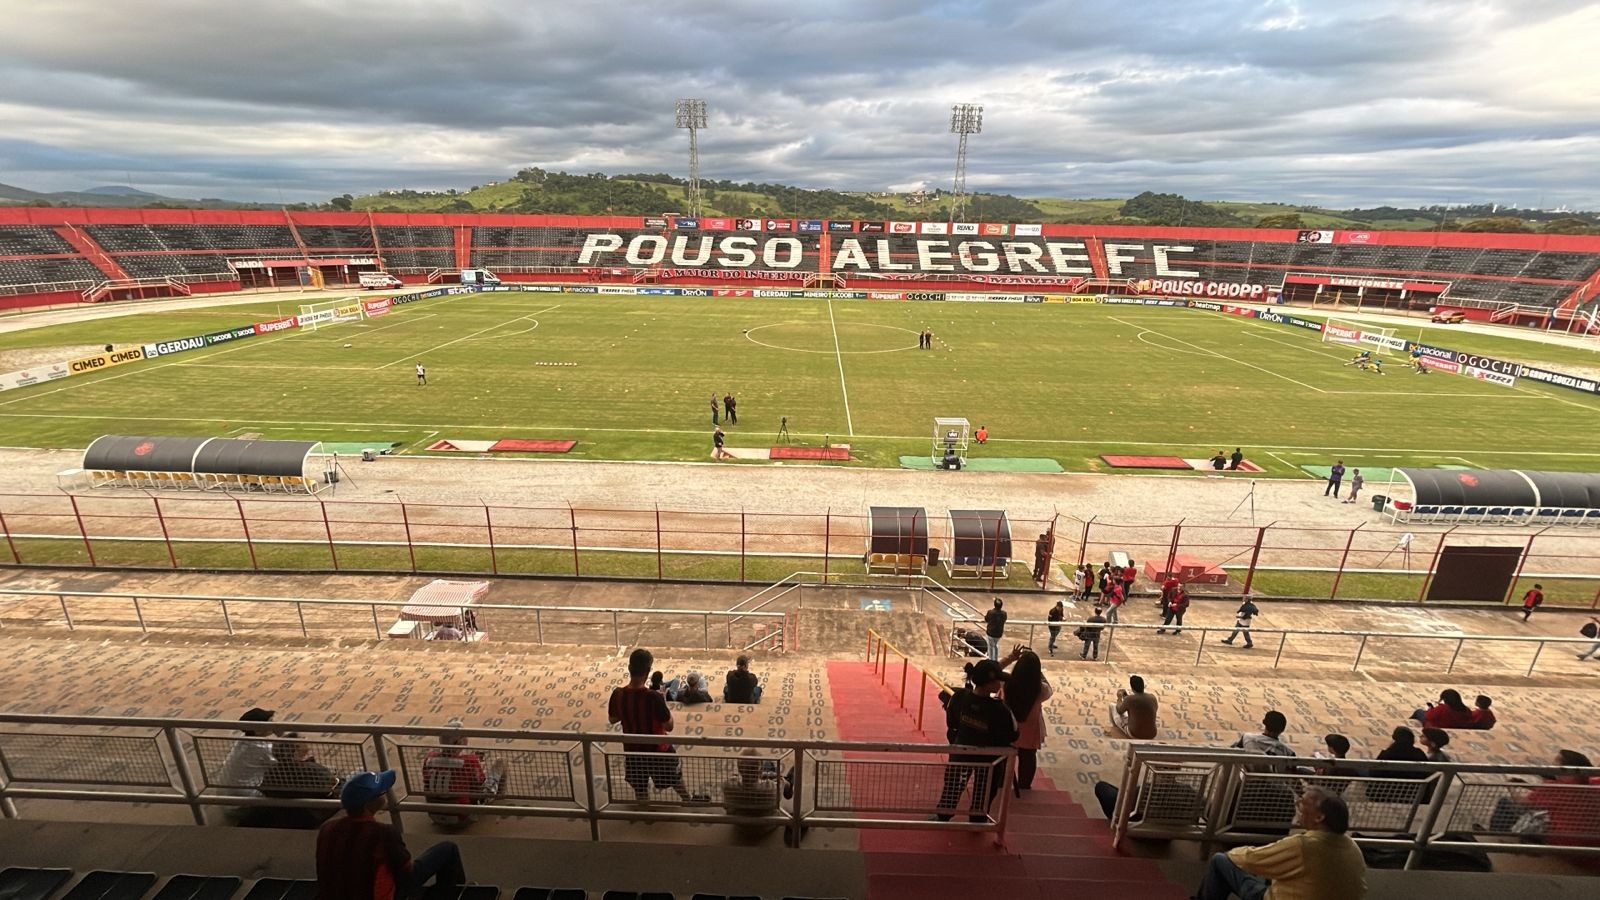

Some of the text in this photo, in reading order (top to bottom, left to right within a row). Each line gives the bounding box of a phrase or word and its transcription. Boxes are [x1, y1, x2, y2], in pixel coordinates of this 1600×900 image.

[577, 234, 1200, 279] POUSO ALEGRE FC
[662, 268, 672, 278] A
[674, 269, 720, 278] MAIOR
[722, 270, 741, 280] DO
[1330, 278, 1405, 289] LANCHONETE
[1151, 281, 1264, 298] POUSO CHOPP
[907, 293, 945, 301] OGOCHI
[259, 318, 294, 332] SUPERBET
[158, 337, 204, 354] GERDAU
[72, 350, 141, 372] CIMED CIMED
[1458, 354, 1519, 376] OGOCHI
[1187, 568, 1195, 577] 1
[1209, 575, 1218, 583] 3
[581, 677, 597, 685] 09
[809, 691, 823, 699] 01
[501, 697, 515, 705] 10
[531, 699, 549, 707] 09
[566, 699, 585, 708] 08
[811, 699, 825, 707] 01
[466, 705, 482, 714] 10
[498, 707, 518, 715] 09
[534, 707, 554, 717] 08
[705, 704, 722, 712] 04
[737, 705, 755, 714] 03
[775, 707, 791, 716] 02
[808, 708, 823, 717] 01
[365, 714, 384, 724] 12
[572, 710, 592, 719] 07
[686, 713, 704, 723] 04
[724, 714, 743, 724] 03
[407, 715, 424, 726] 11
[482, 718, 503, 728] 09
[520, 719, 543, 730] 08
[768, 715, 785, 726] 02
[807, 717, 824, 727] 01
[1048, 715, 1067, 725] 78
[1084, 718, 1102, 726] 77
[561, 721, 582, 731] 07
[684, 726, 704, 736] 04
[725, 726, 744, 737] 03
[767, 728, 787, 739] 02
[809, 730, 826, 740] 01
[1055, 726, 1075, 737] 79
[1067, 739, 1089, 750] 80
[1080, 753, 1102, 766] 80
